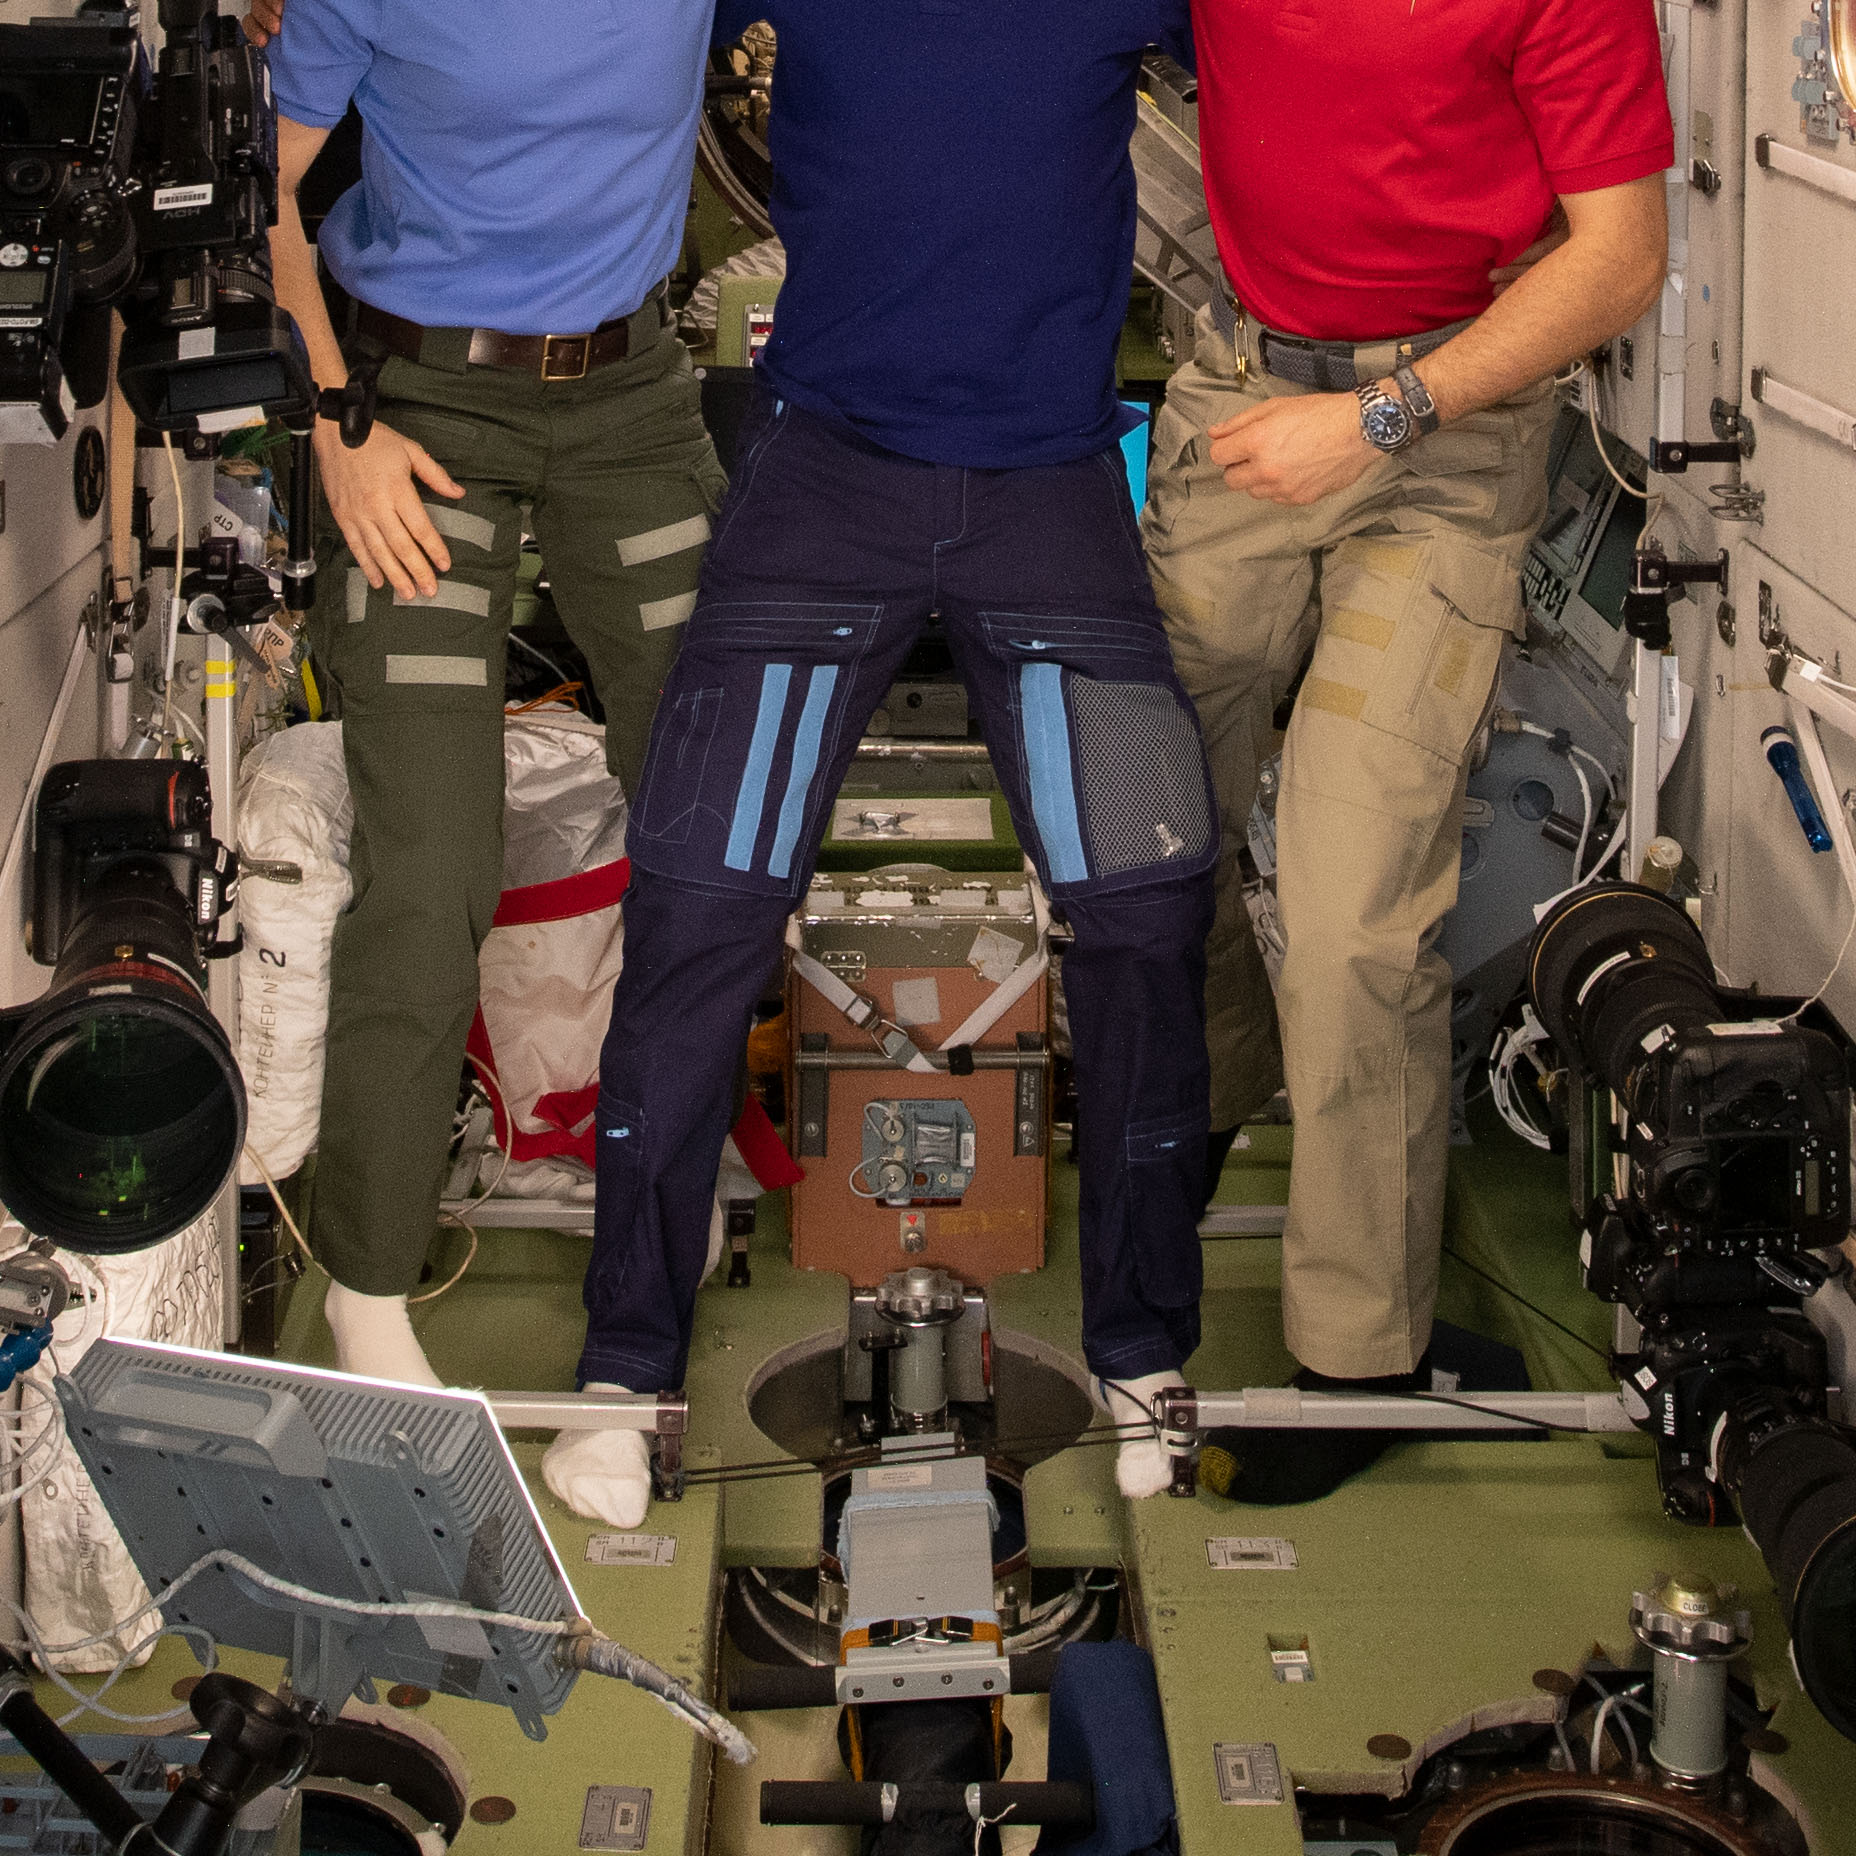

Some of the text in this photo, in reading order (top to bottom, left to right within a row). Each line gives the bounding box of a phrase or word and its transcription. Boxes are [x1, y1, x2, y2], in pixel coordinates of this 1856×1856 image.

[198, 877, 213, 919] Nikon
[257, 946, 287, 968] 2
[252, 1003, 278, 1099] КОНТЕЙНЕР
[1661, 1391, 1679, 1435] Nikon
